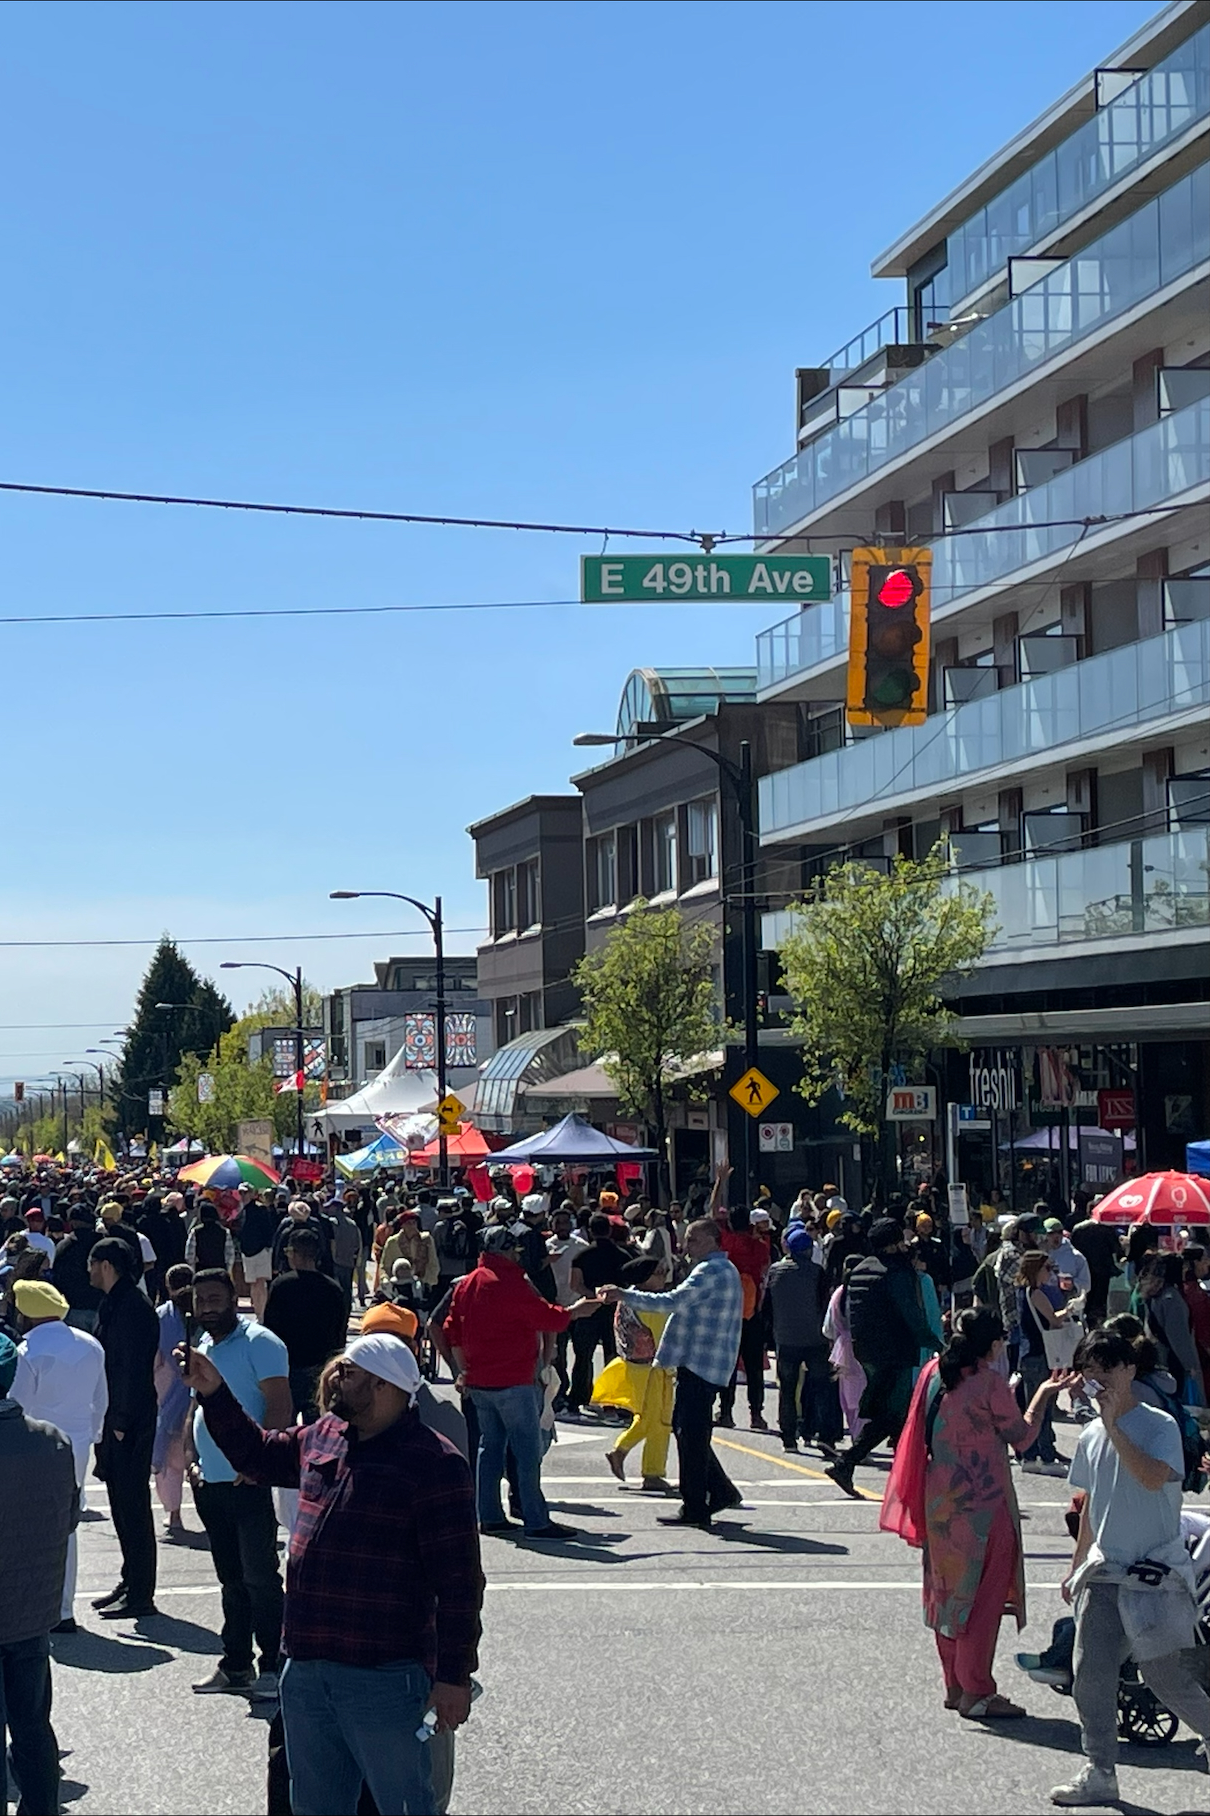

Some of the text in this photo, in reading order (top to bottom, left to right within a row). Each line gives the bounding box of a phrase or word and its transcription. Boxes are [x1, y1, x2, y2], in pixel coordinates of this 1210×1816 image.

[601, 562, 814, 594] E 49th Ave
[969, 1051, 1016, 1110] freshii
